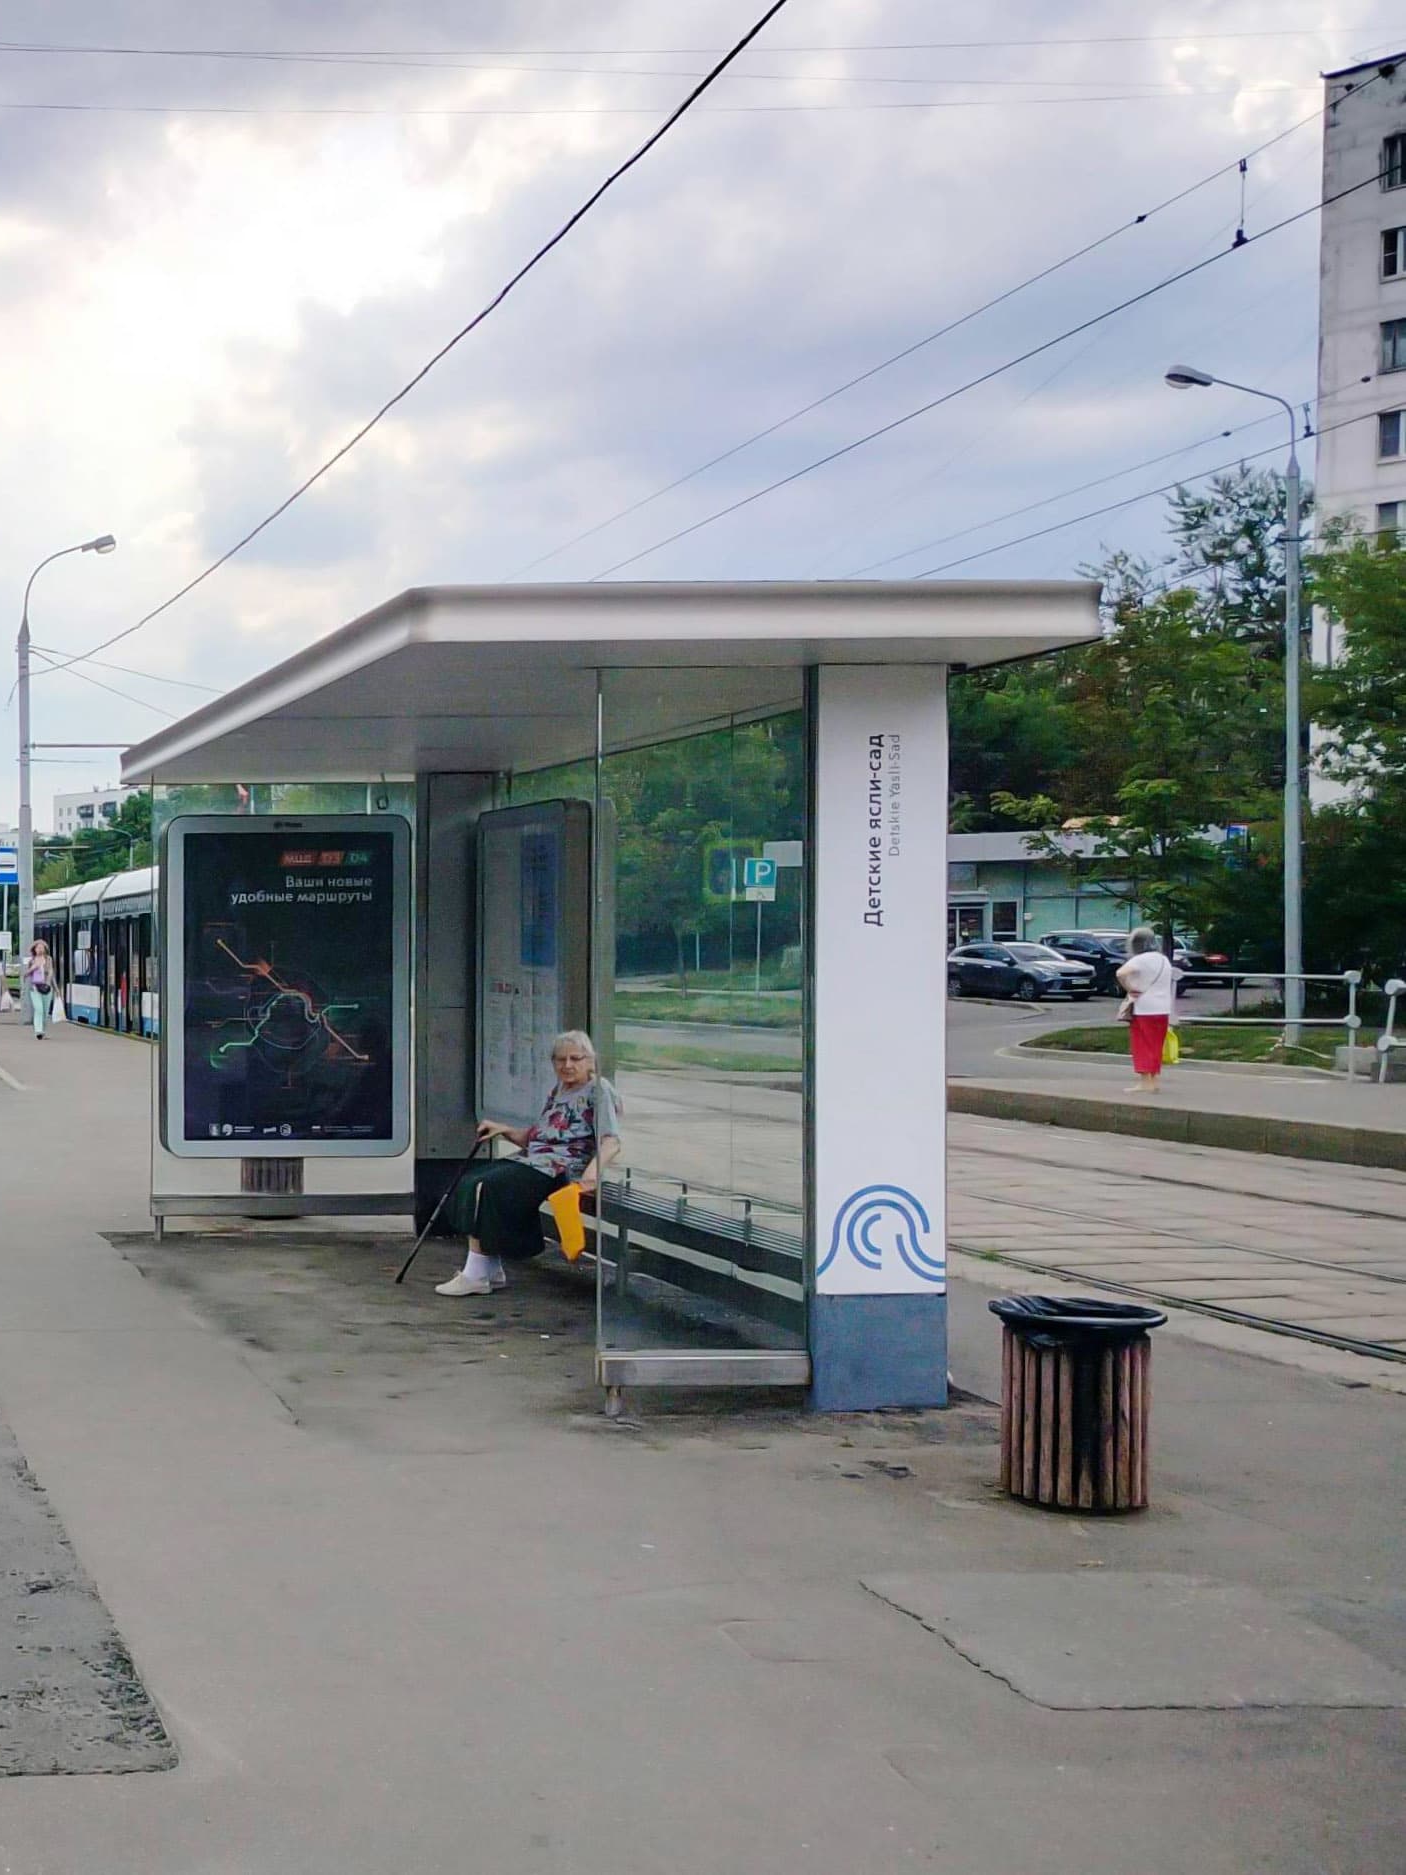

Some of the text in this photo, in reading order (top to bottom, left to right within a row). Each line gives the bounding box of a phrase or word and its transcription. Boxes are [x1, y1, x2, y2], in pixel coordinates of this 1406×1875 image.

[864, 734, 885, 927] Детские ясли-сад
[888, 802, 901, 857] Detskie
[285, 875, 373, 888] Ваши новые
[756, 862, 772, 884] P
[231, 889, 373, 905] удобные маршруты
